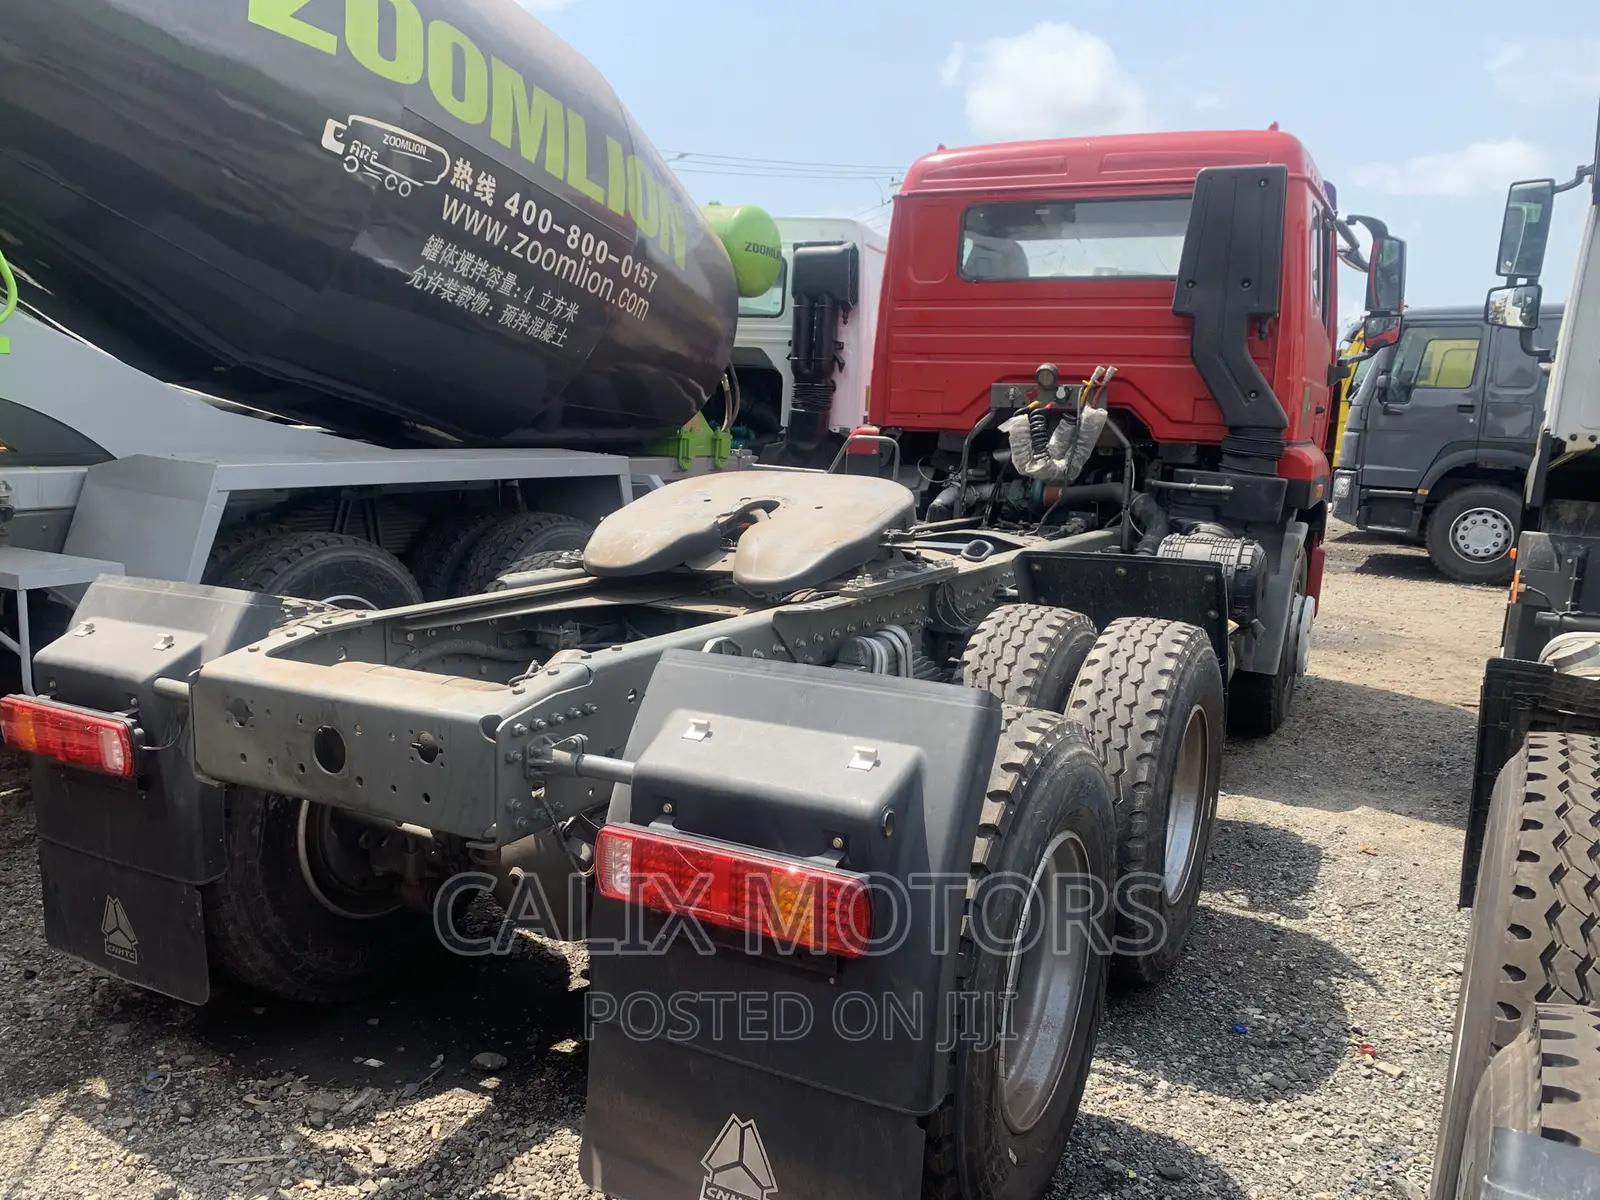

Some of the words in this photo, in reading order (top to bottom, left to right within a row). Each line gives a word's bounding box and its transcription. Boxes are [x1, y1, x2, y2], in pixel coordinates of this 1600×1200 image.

[383, 133, 427, 157] ZOOMLION
[450, 157, 497, 207] 热线
[504, 192, 658, 293] 400-800-0157
[535, 290, 580, 323] 立方米
[107, 944, 135, 960] CNHTC
